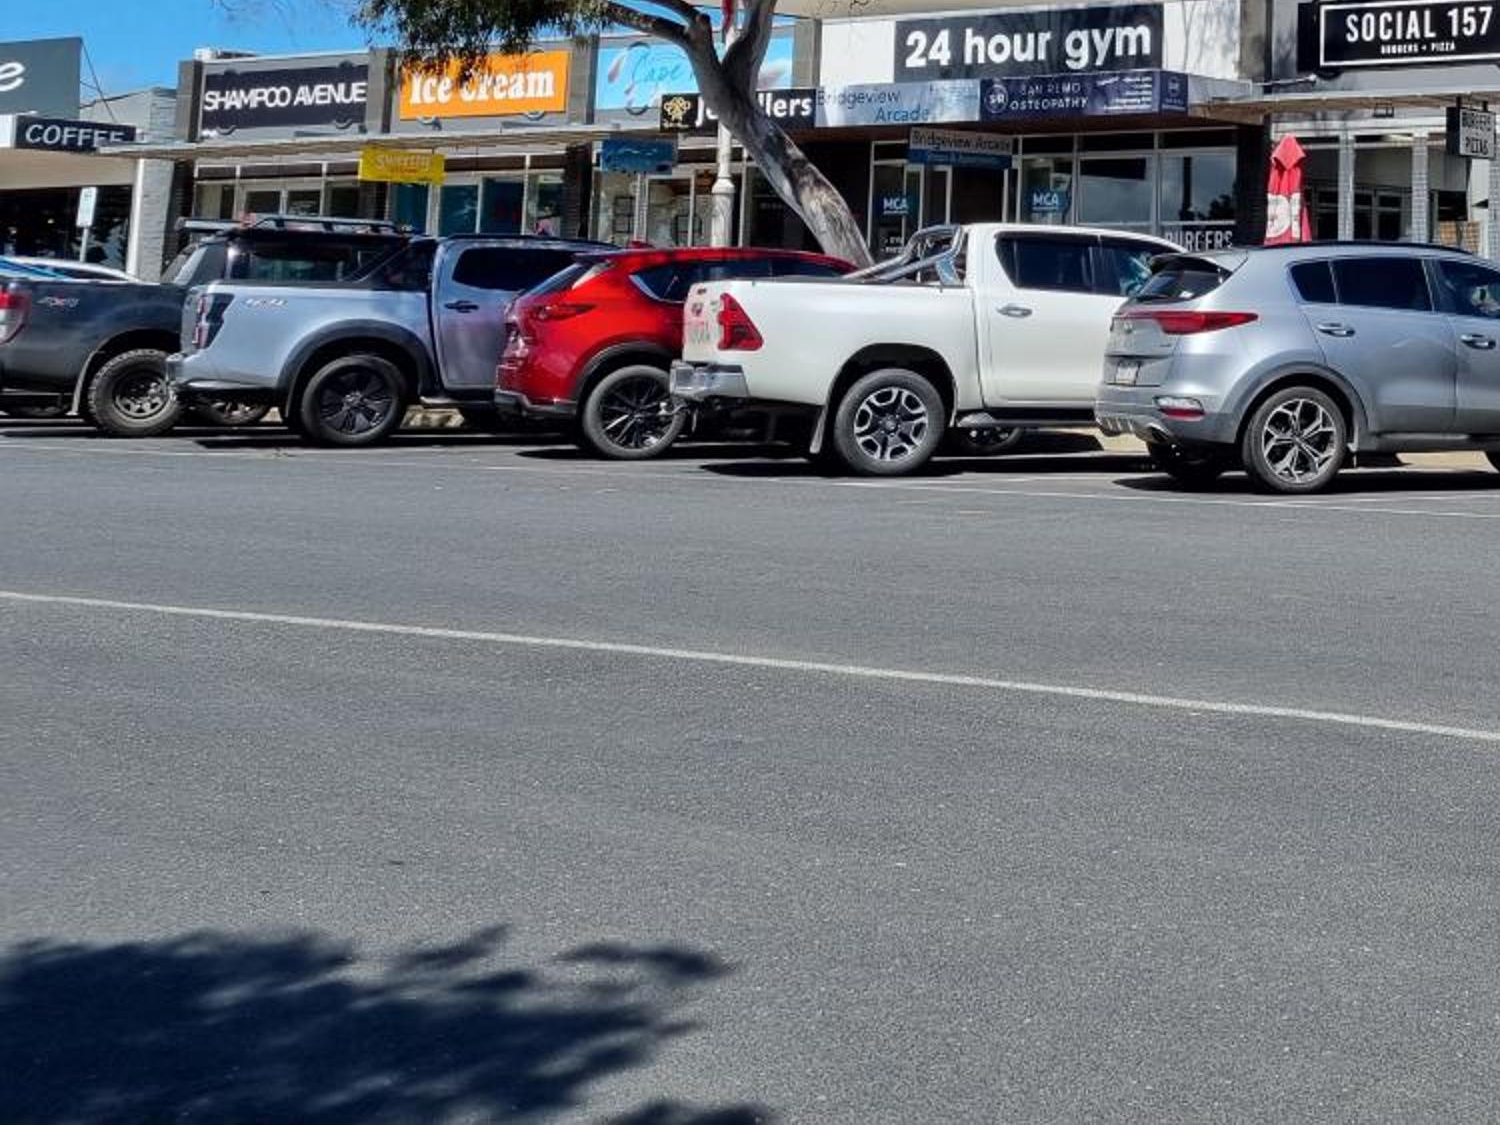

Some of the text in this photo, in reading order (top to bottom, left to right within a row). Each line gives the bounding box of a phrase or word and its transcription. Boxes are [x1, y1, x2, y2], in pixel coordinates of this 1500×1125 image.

[1346, 6, 1493, 43] SOCIAL 157
[905, 25, 1151, 69] 24 hour gym
[1431, 40, 1456, 52] PIZZA
[204, 82, 367, 112] SHAMPOO AVENUE
[410, 72, 453, 105] Ice
[1021, 84, 1043, 96] SAN
[817, 89, 900, 109] Bridgeview
[1010, 96, 1088, 110] OSTEOPATHY
[695, 92, 813, 127] Jllers
[873, 105, 930, 123] Arcade
[883, 197, 908, 210] MCA
[1033, 193, 1059, 205] MCA
